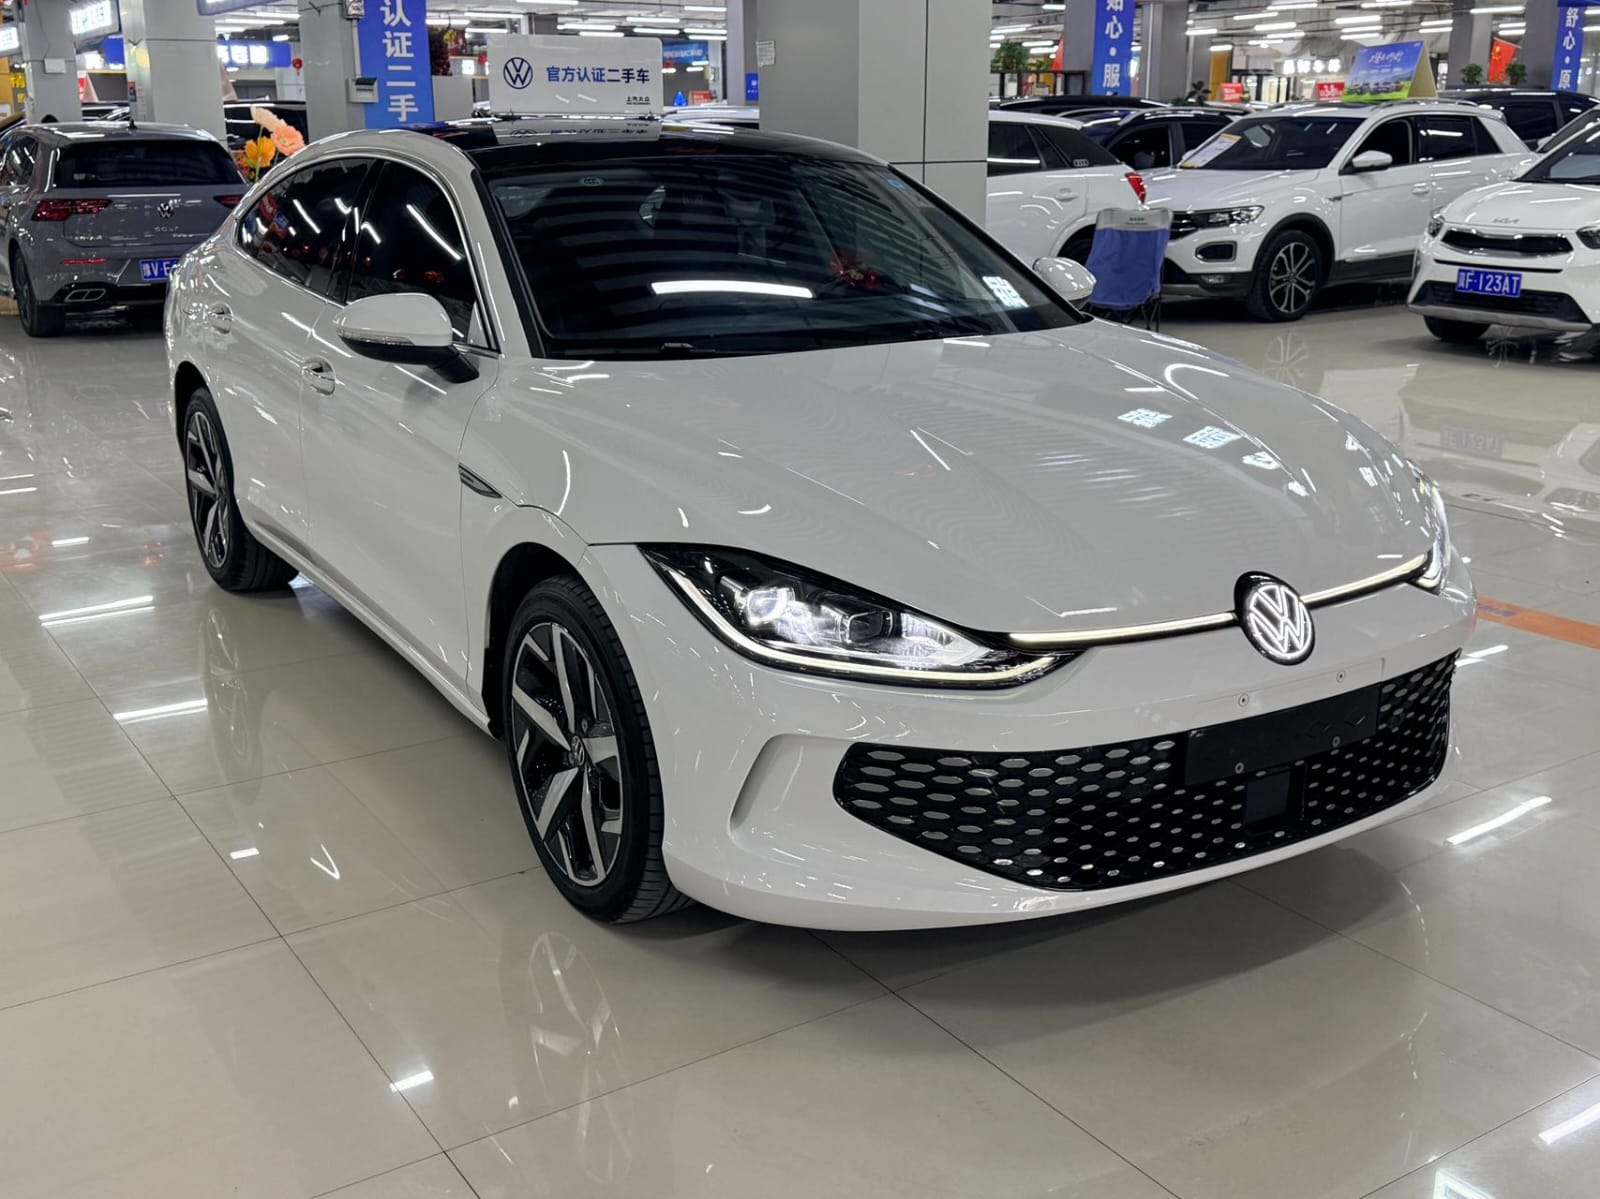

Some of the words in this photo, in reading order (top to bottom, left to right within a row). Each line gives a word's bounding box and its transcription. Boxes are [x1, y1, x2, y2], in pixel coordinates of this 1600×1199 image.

[546, 66, 650, 84] 官方认证二手车
